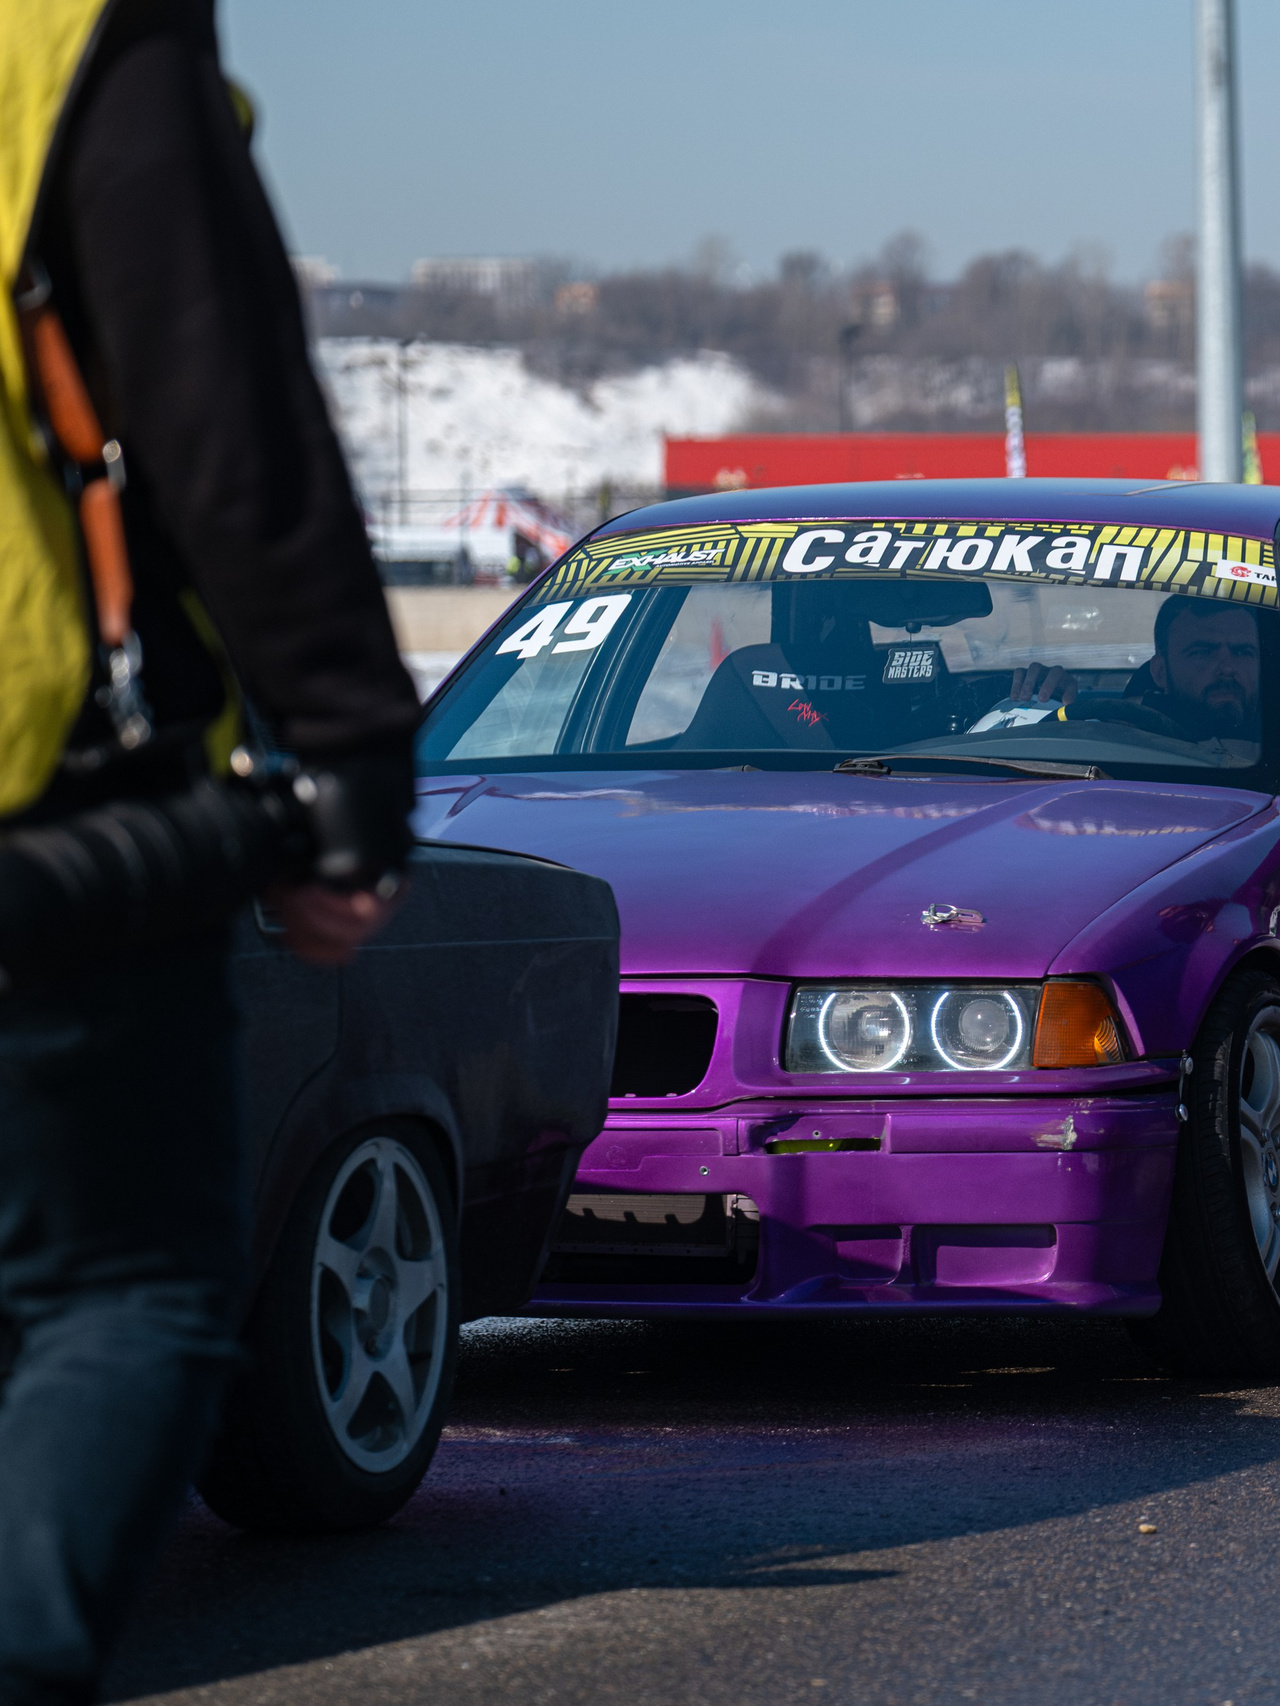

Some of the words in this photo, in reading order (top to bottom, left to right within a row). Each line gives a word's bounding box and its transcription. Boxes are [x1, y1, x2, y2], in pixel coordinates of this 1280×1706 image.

[608, 548, 726, 571] EXHAUST
[495, 594, 632, 660] 49
[892, 650, 935, 667] SIDE
[751, 670, 867, 691] BRIDE
[887, 664, 934, 679] MASTERS
